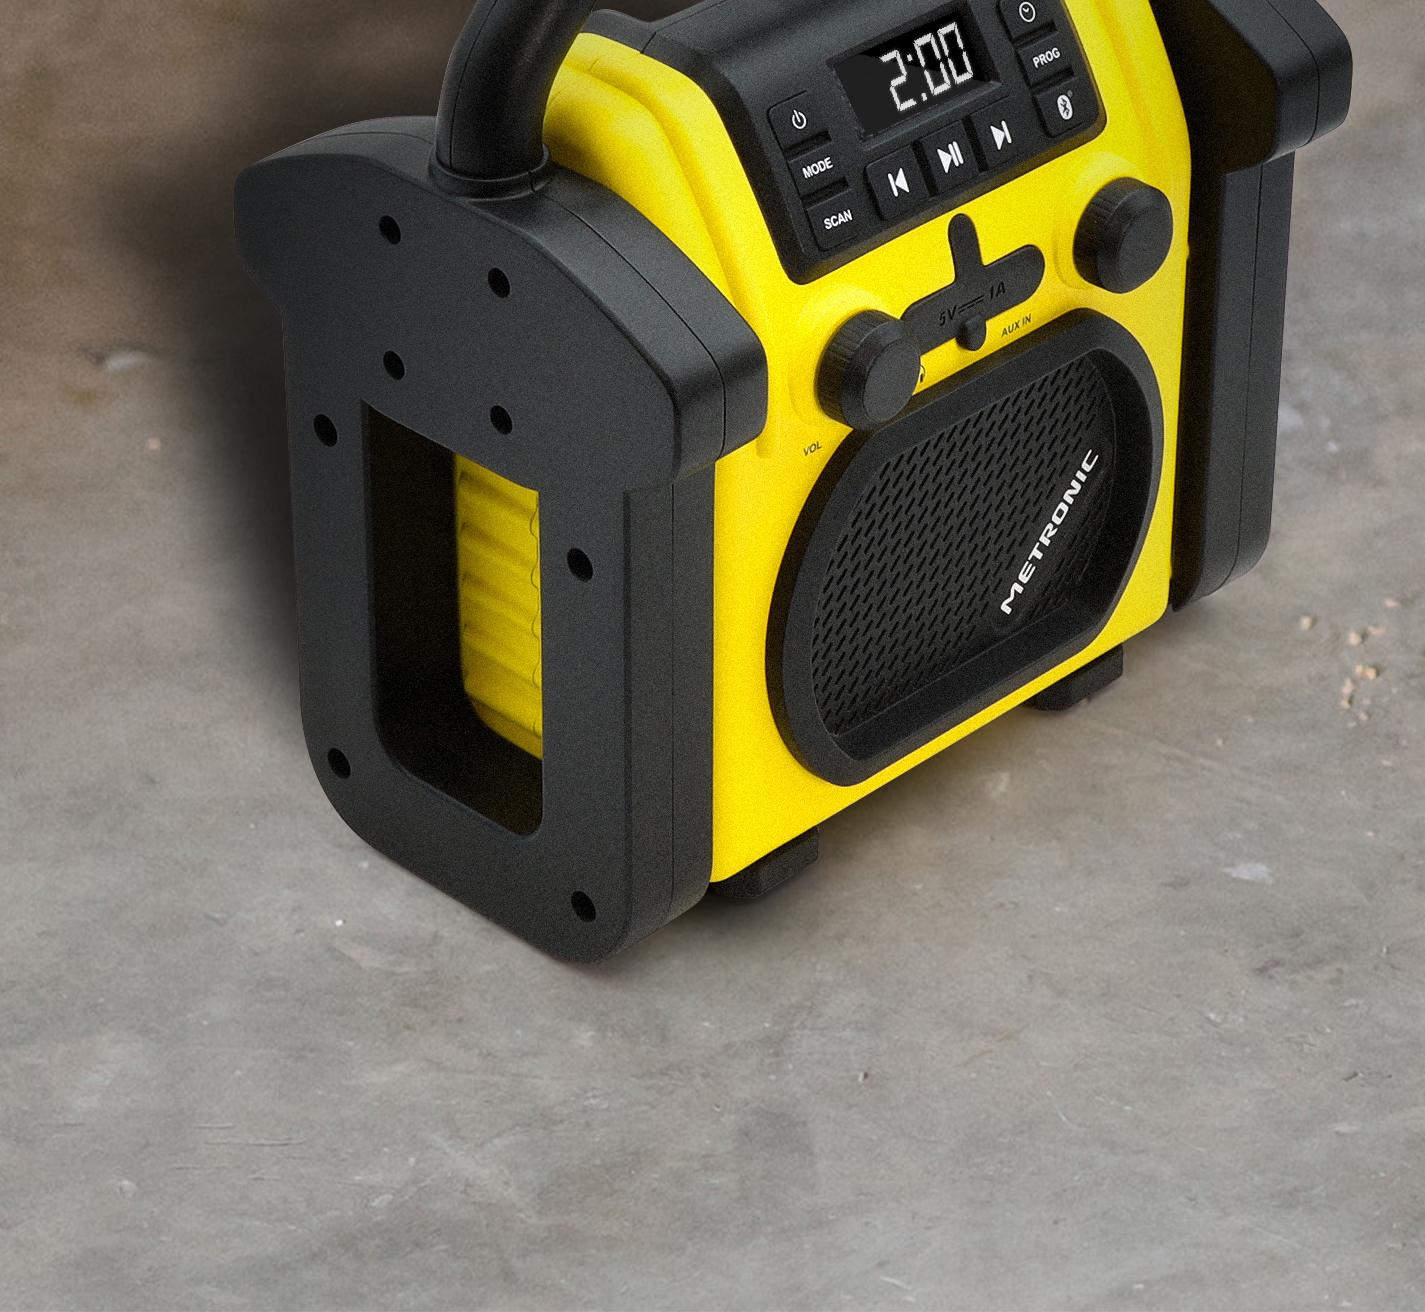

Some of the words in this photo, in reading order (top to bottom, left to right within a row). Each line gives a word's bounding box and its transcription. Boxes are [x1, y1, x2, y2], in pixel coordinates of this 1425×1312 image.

[879, 21, 973, 112] 2:00
[1033, 47, 1060, 68] PROG
[802, 157, 833, 178] MODE
[824, 209, 852, 229] SCAN
[1001, 321, 1020, 337] AUX
[1022, 314, 1031, 327] IN
[803, 441, 822, 456] VOL
[1000, 449, 1100, 614] METRONIC
